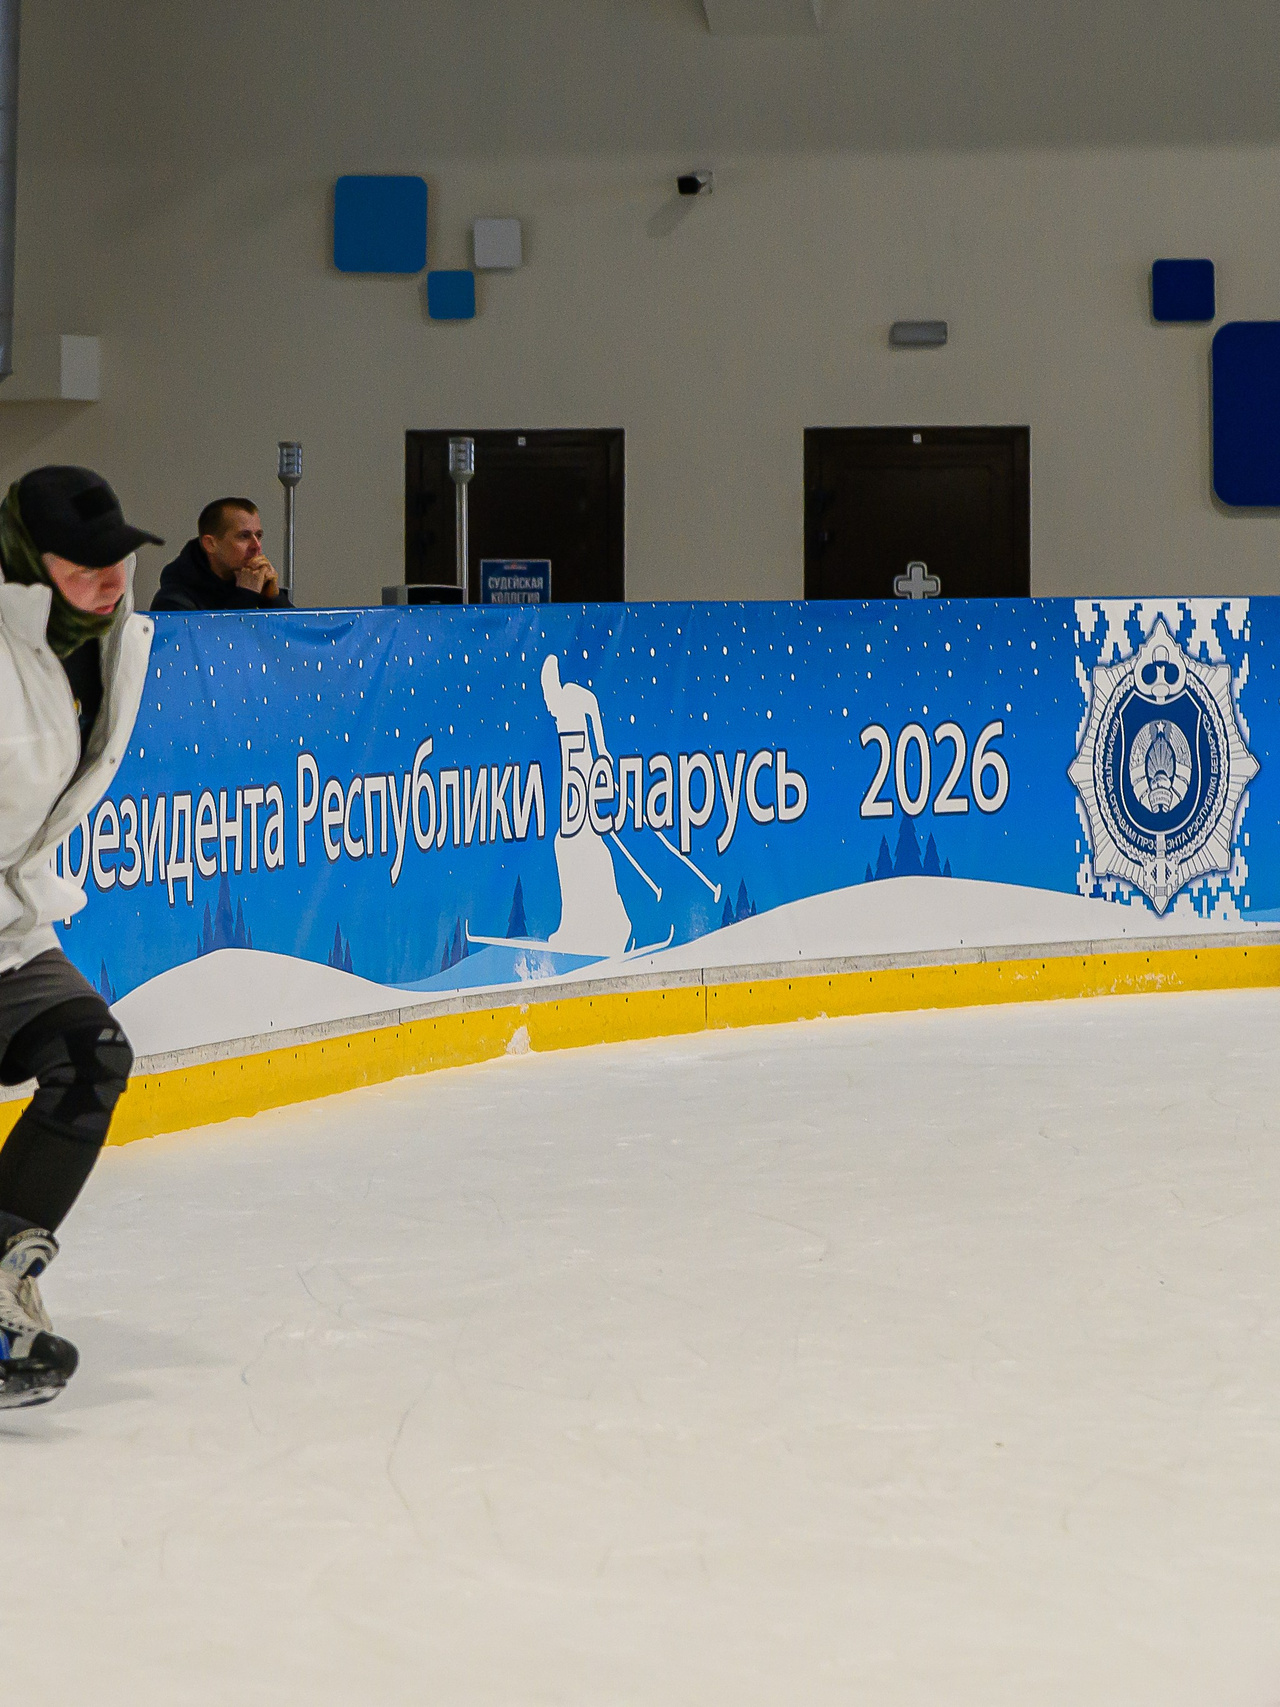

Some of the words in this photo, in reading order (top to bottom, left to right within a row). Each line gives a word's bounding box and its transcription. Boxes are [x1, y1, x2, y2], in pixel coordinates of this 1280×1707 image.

[488, 575, 544, 590] СУДЕЙСКАЯ
[49, 782, 285, 930] резидента
[296, 736, 545, 886] Республики
[560, 731, 807, 854] Беларусь
[860, 720, 1009, 818] 2026
